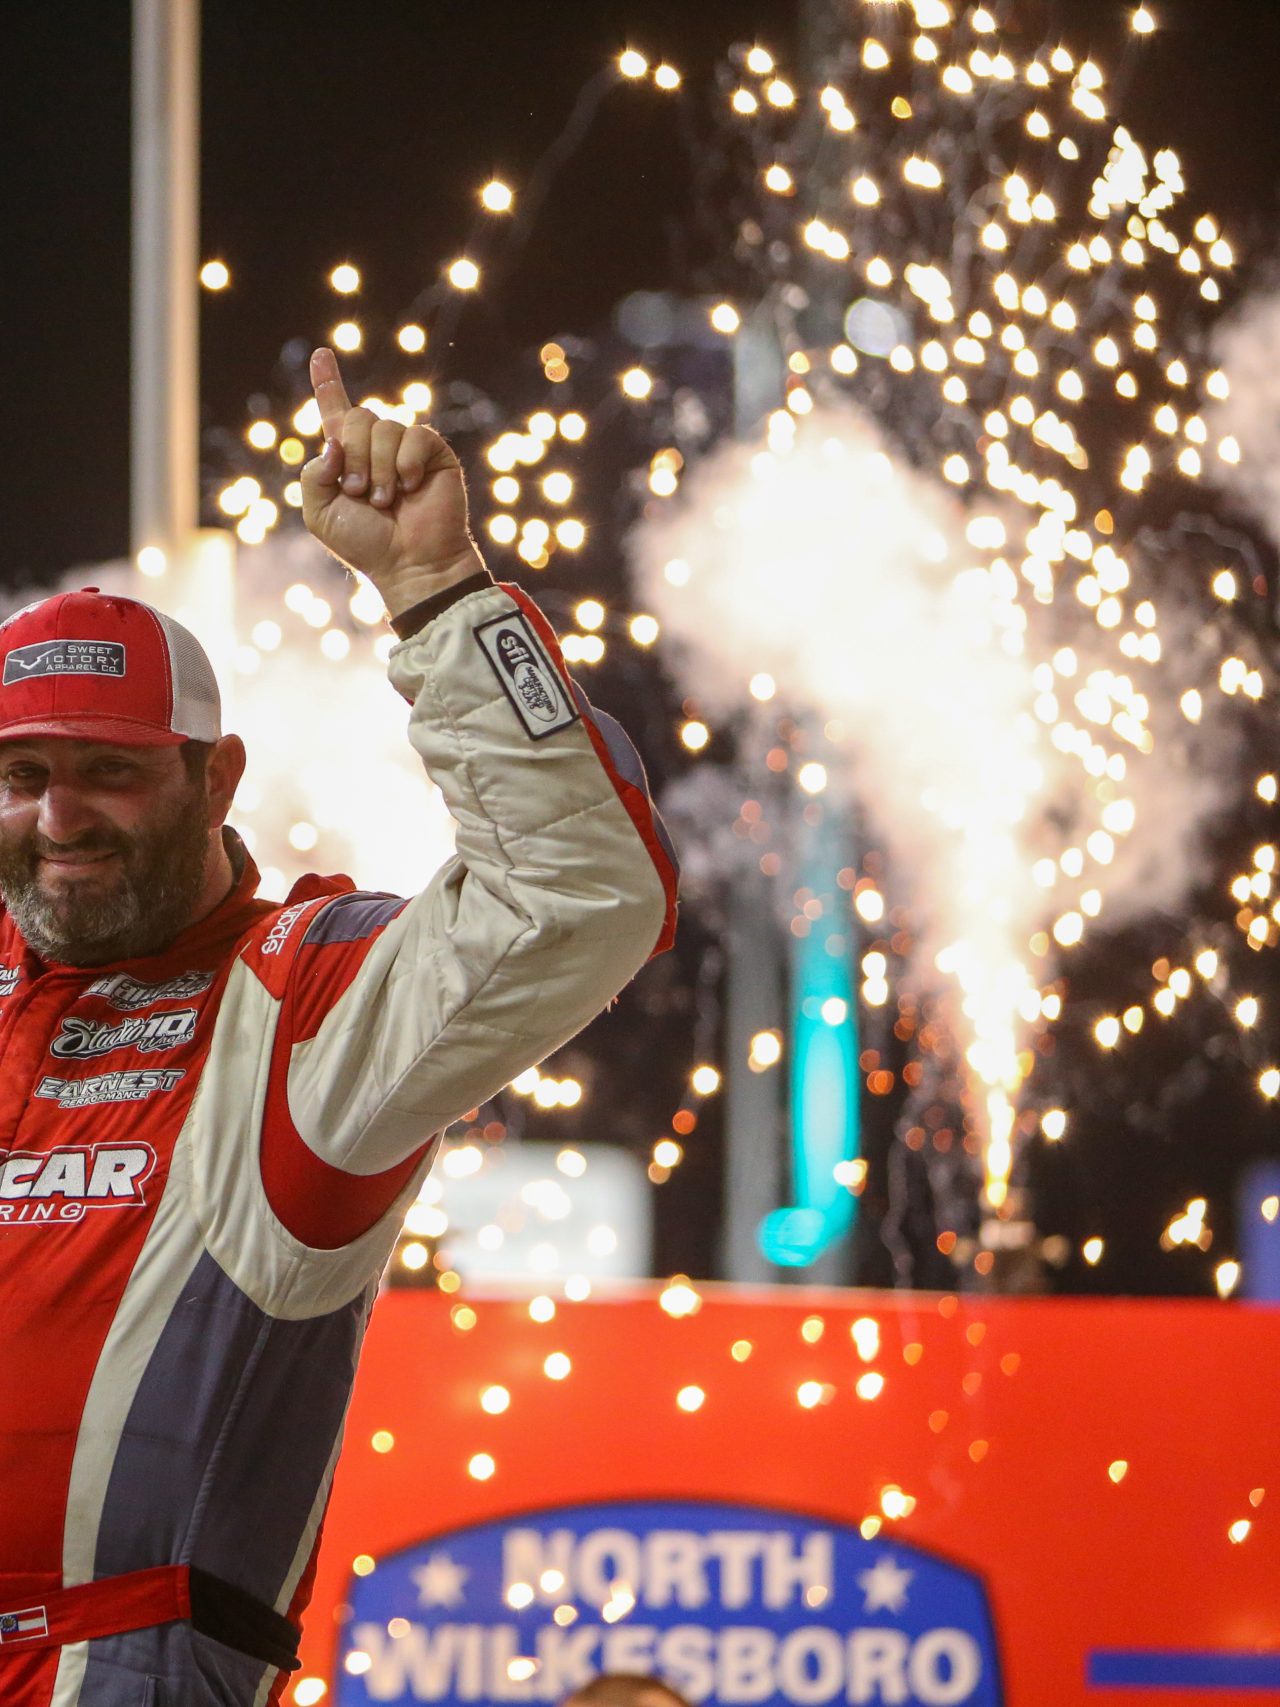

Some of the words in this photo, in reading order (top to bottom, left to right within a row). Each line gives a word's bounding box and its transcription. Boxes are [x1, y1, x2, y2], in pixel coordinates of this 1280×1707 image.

[67, 645, 113, 654] SWEET
[46, 663, 96, 671] APPAREL
[51, 1018, 145, 1054] Studio
[141, 1012, 195, 1038] 10
[36, 1070, 185, 1098] EARNEST
[60, 1089, 148, 1108] PERFORMANCE
[503, 1529, 833, 1610] NORTH
[354, 1624, 980, 1705] WILKESBORO
